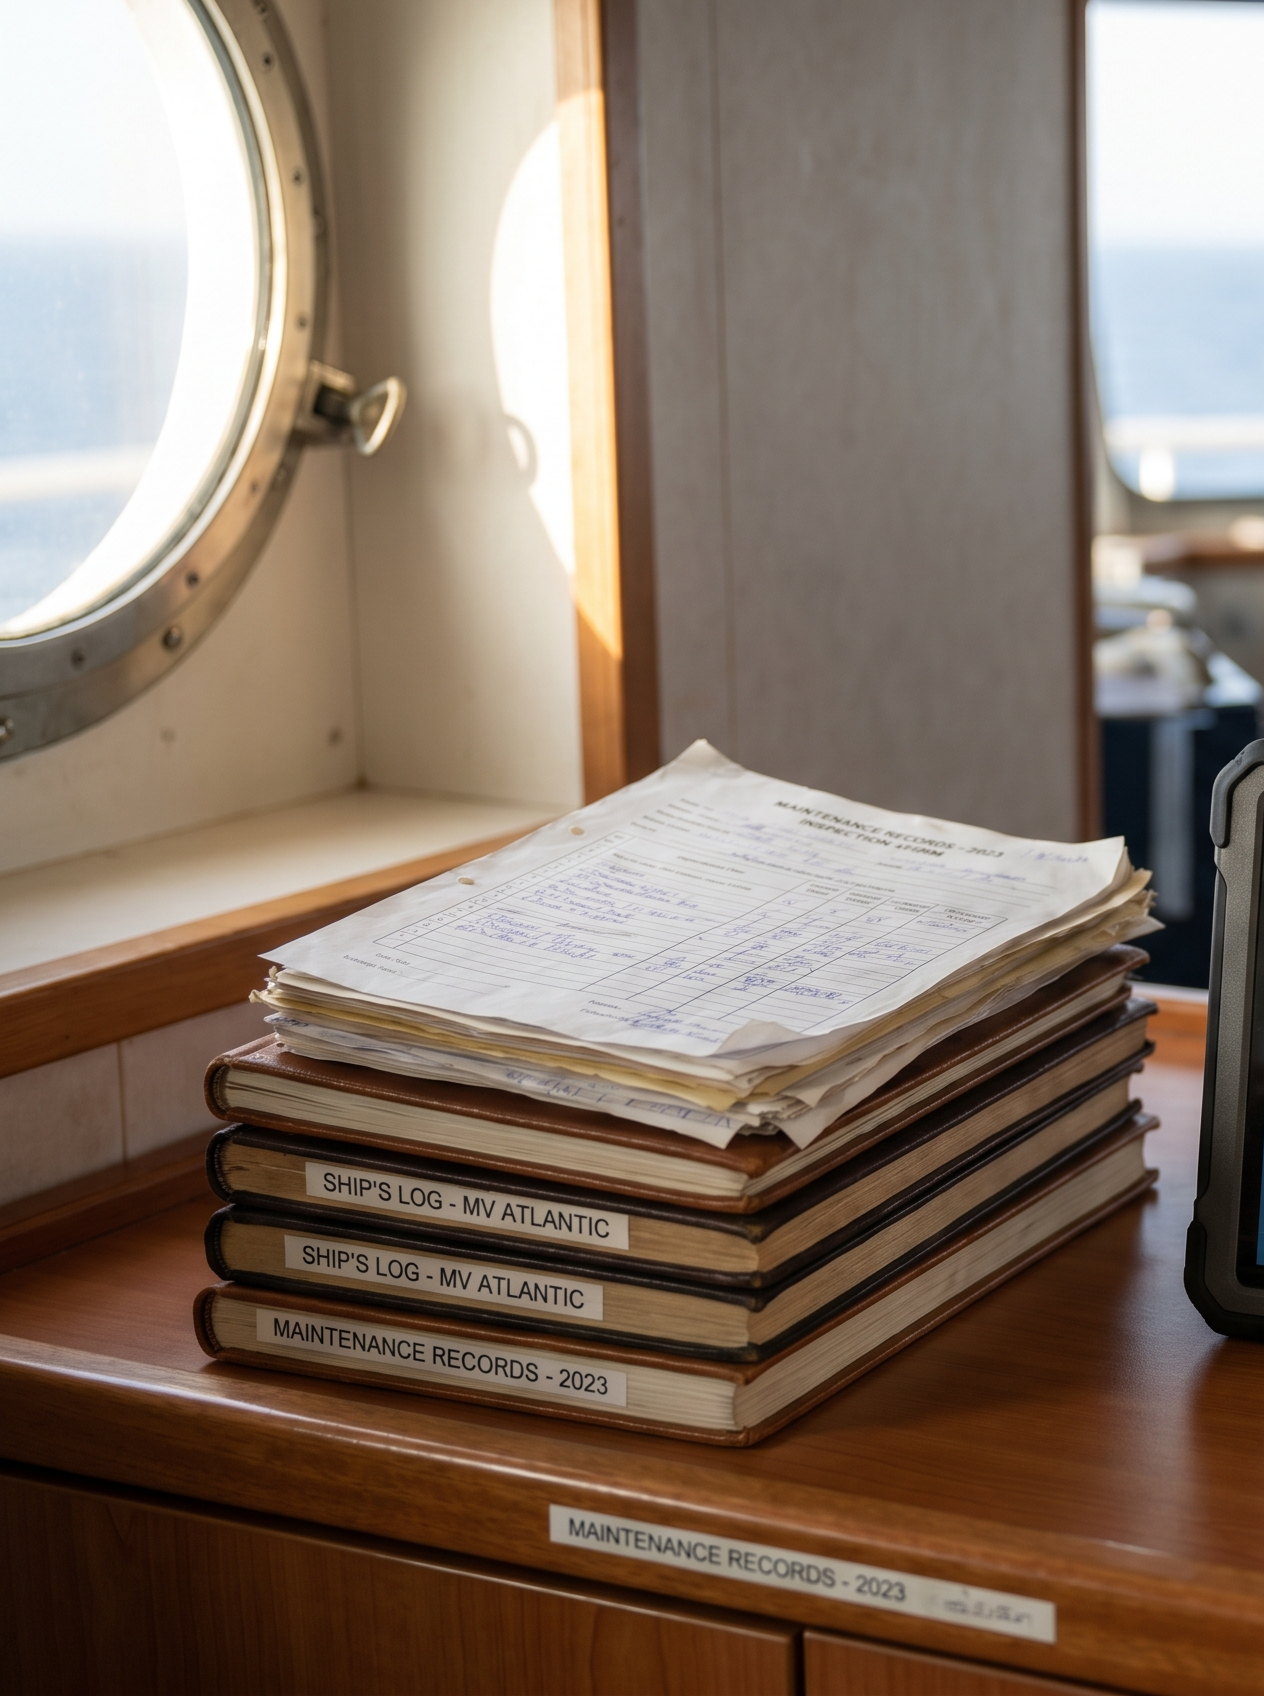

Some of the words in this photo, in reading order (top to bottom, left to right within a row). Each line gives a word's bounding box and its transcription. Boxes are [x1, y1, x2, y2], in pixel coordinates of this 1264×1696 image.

[774, 800, 884, 835] MAINTENANCE
[323, 1172, 392, 1203] SHIP'S
[397, 1185, 443, 1211] LOG
[463, 1195, 496, 1219] MV
[501, 1202, 611, 1239] ATLANTIC
[301, 1244, 369, 1274] SHIP'S
[375, 1256, 420, 1283] LOG
[439, 1267, 473, 1291] MV
[477, 1273, 585, 1310] ATLANTIC
[273, 1317, 426, 1363] MAINTENANCE
[432, 1345, 539, 1383] RECORDS
[559, 1368, 609, 1396] 2023
[568, 1517, 722, 1566] MAINTENANCE
[728, 1548, 836, 1589] RECORDS
[855, 1573, 907, 1603] 2023
